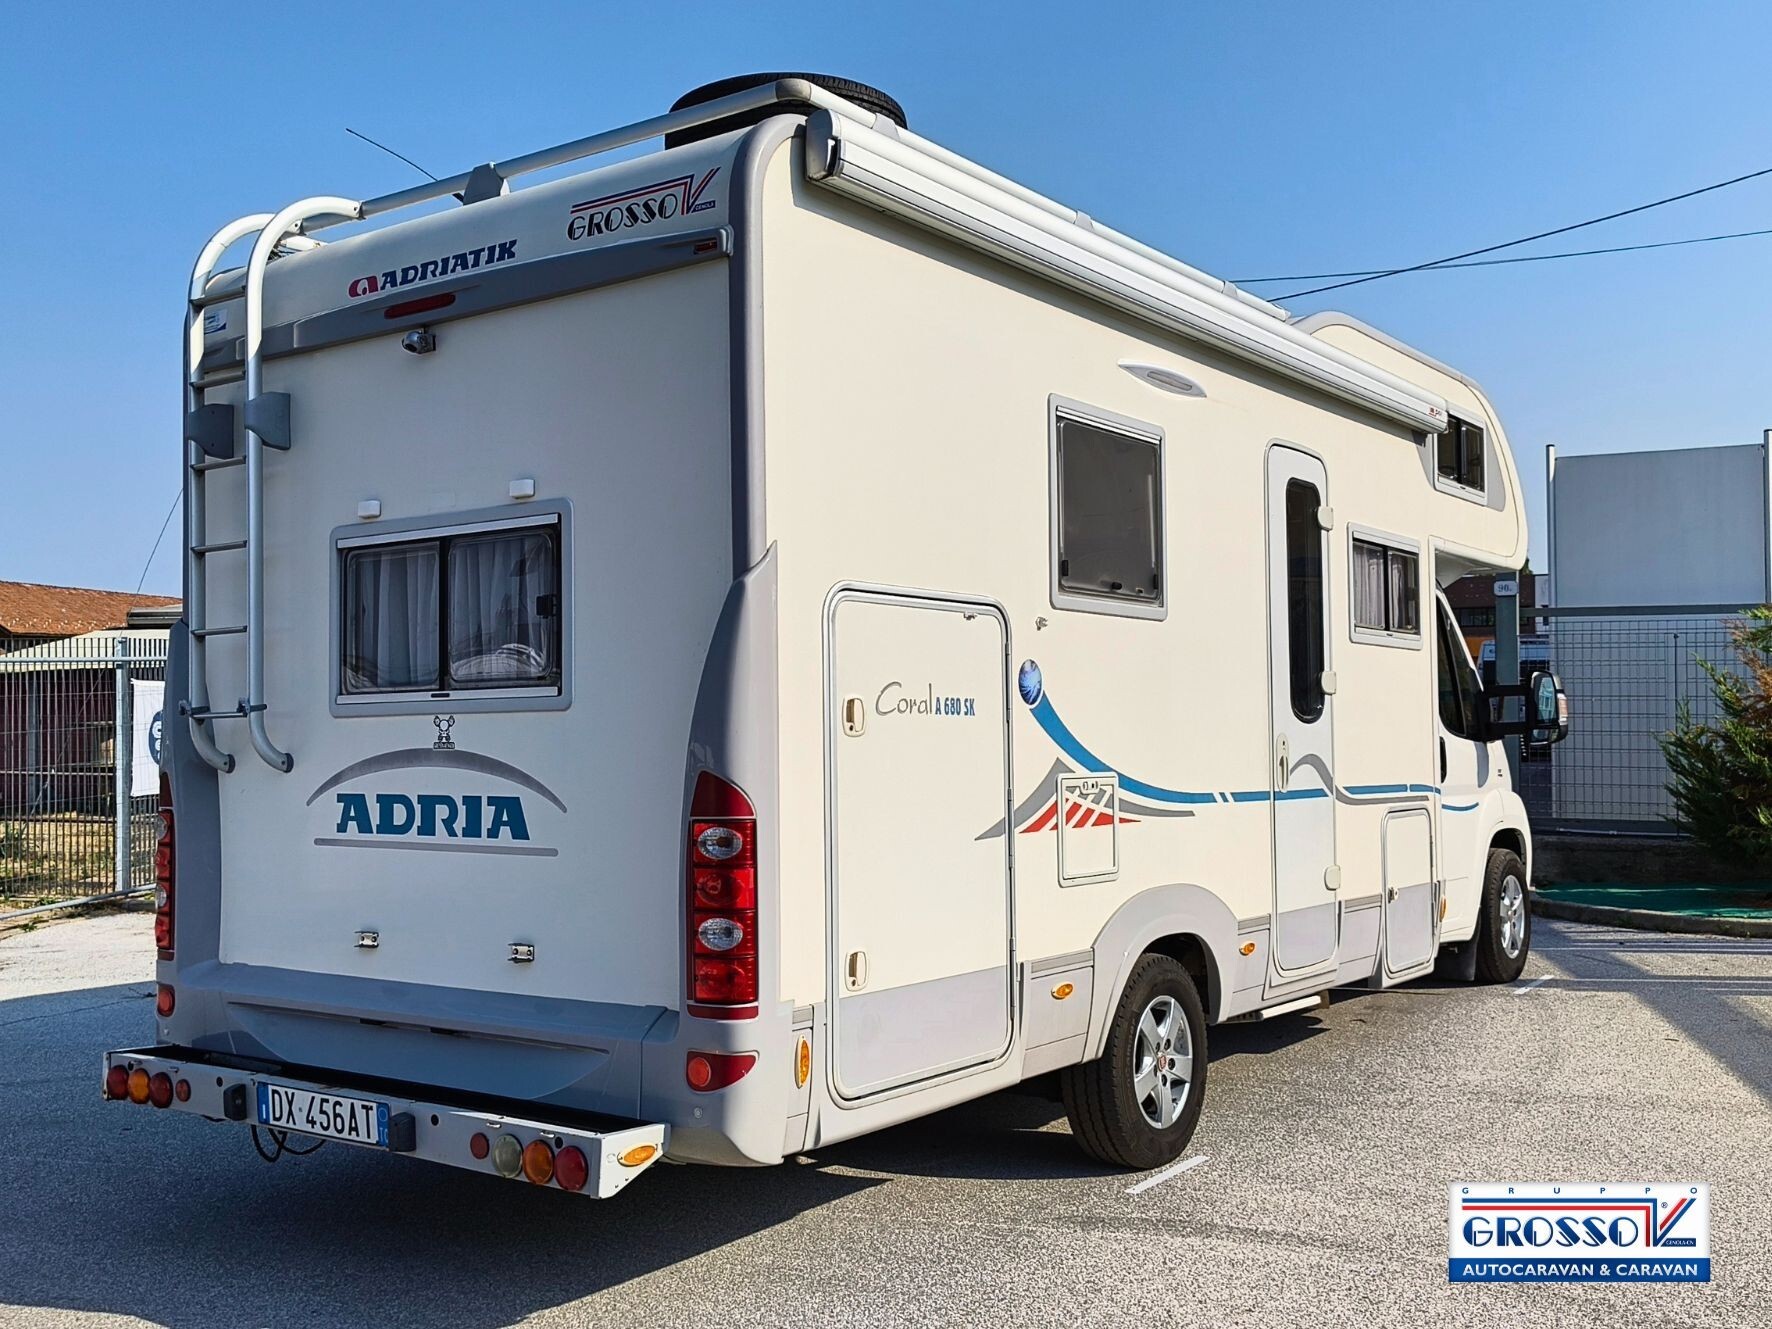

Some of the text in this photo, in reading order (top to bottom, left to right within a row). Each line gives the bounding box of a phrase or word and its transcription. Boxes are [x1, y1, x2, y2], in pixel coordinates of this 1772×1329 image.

[567, 193, 678, 241] GROSSO
[380, 239, 517, 291] ADRIATIK
[875, 681, 975, 716] Coral A 680 SK
[336, 793, 530, 841] ADRIA
[271, 1089, 373, 1140] DX 456AT
